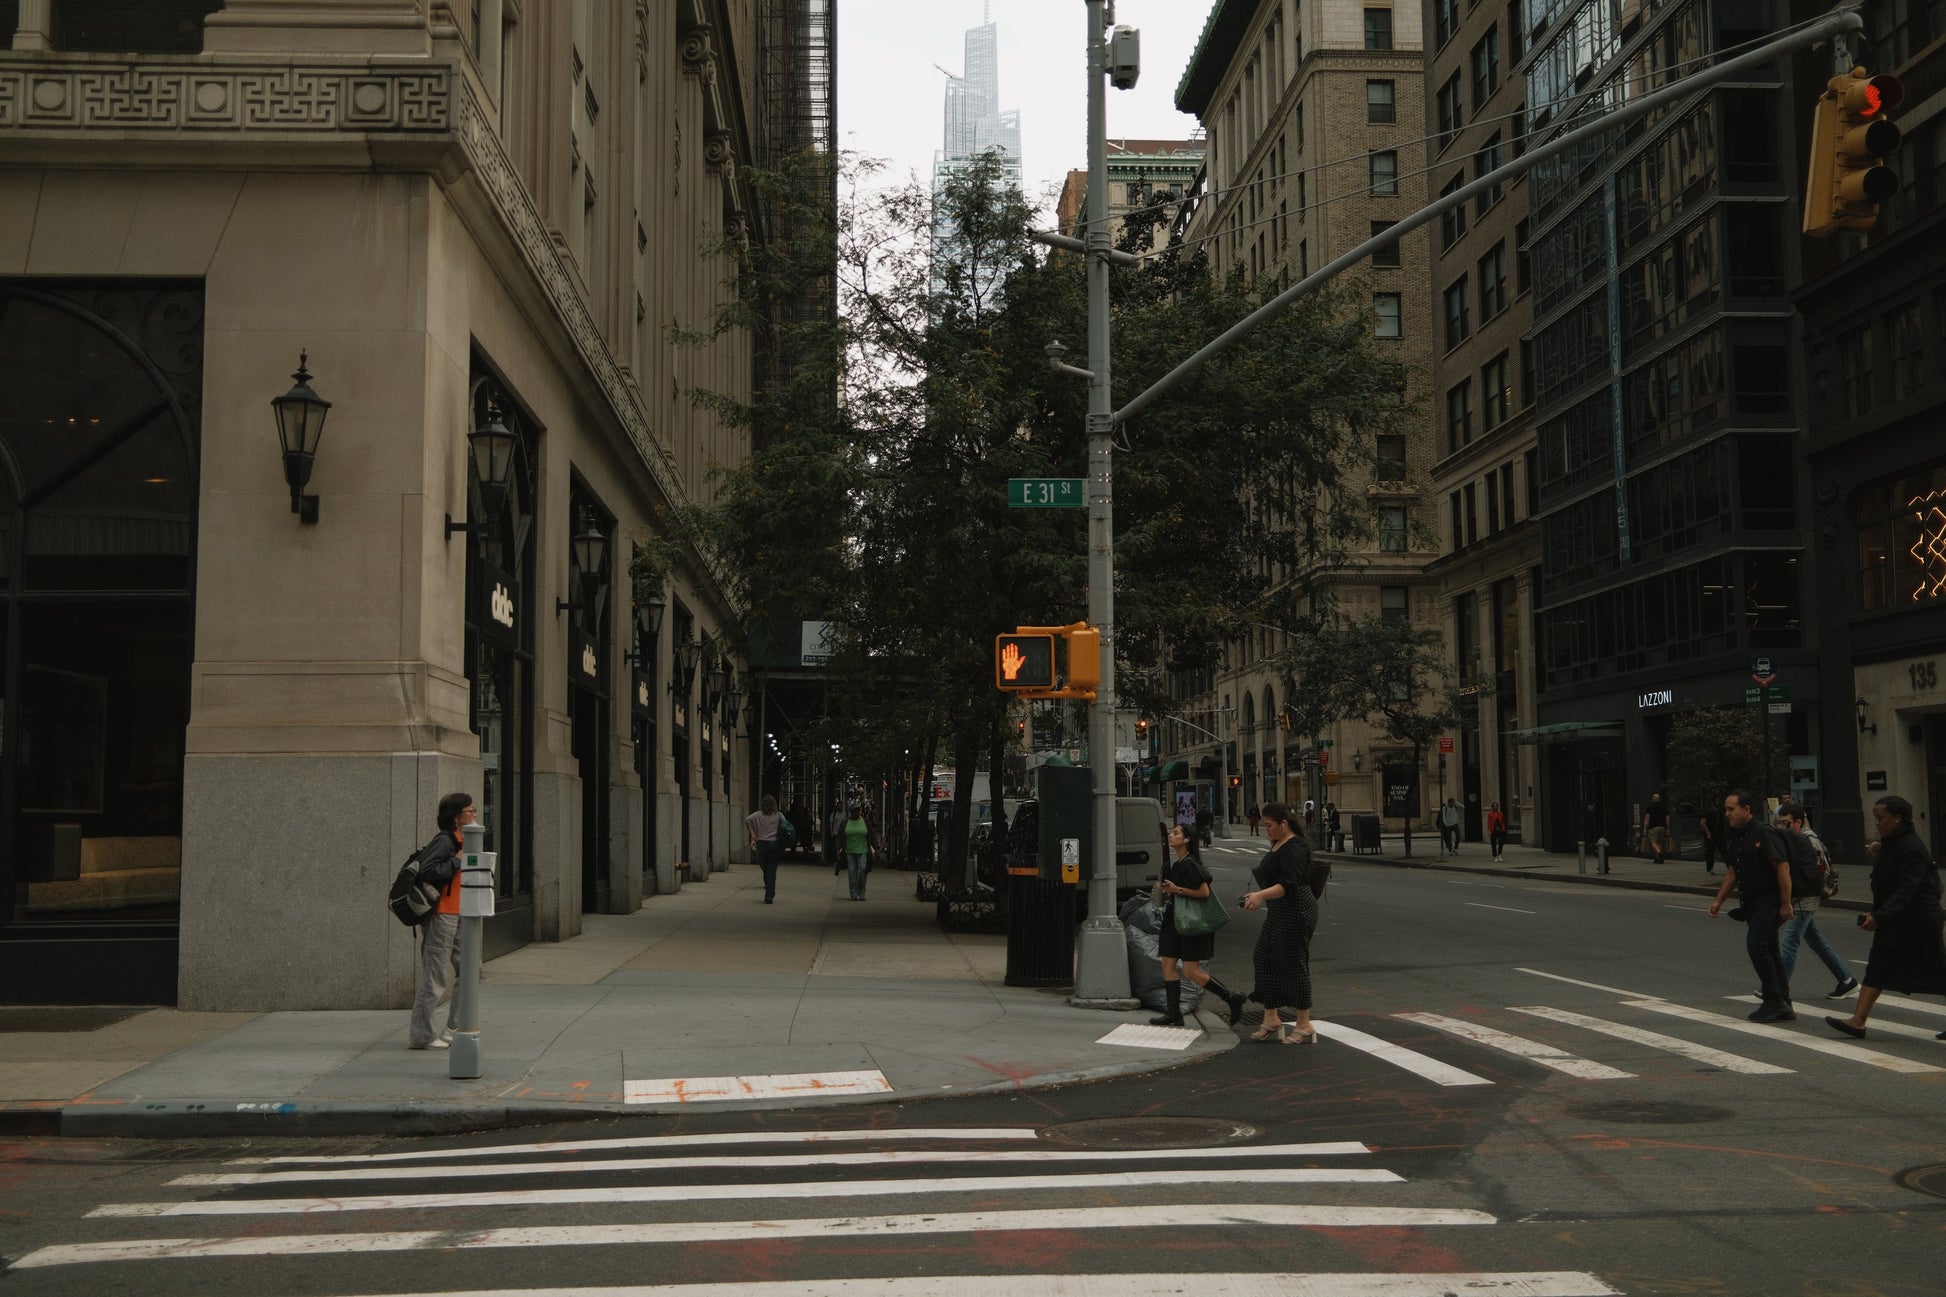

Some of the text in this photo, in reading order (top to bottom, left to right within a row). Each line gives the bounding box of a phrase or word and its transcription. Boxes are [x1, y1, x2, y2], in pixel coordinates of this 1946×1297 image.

[1023, 481, 1071, 503] E 31 St
[491, 582, 514, 628] ddc
[1908, 662, 1937, 690] 135
[1638, 690, 1673, 708] LAZZONI
